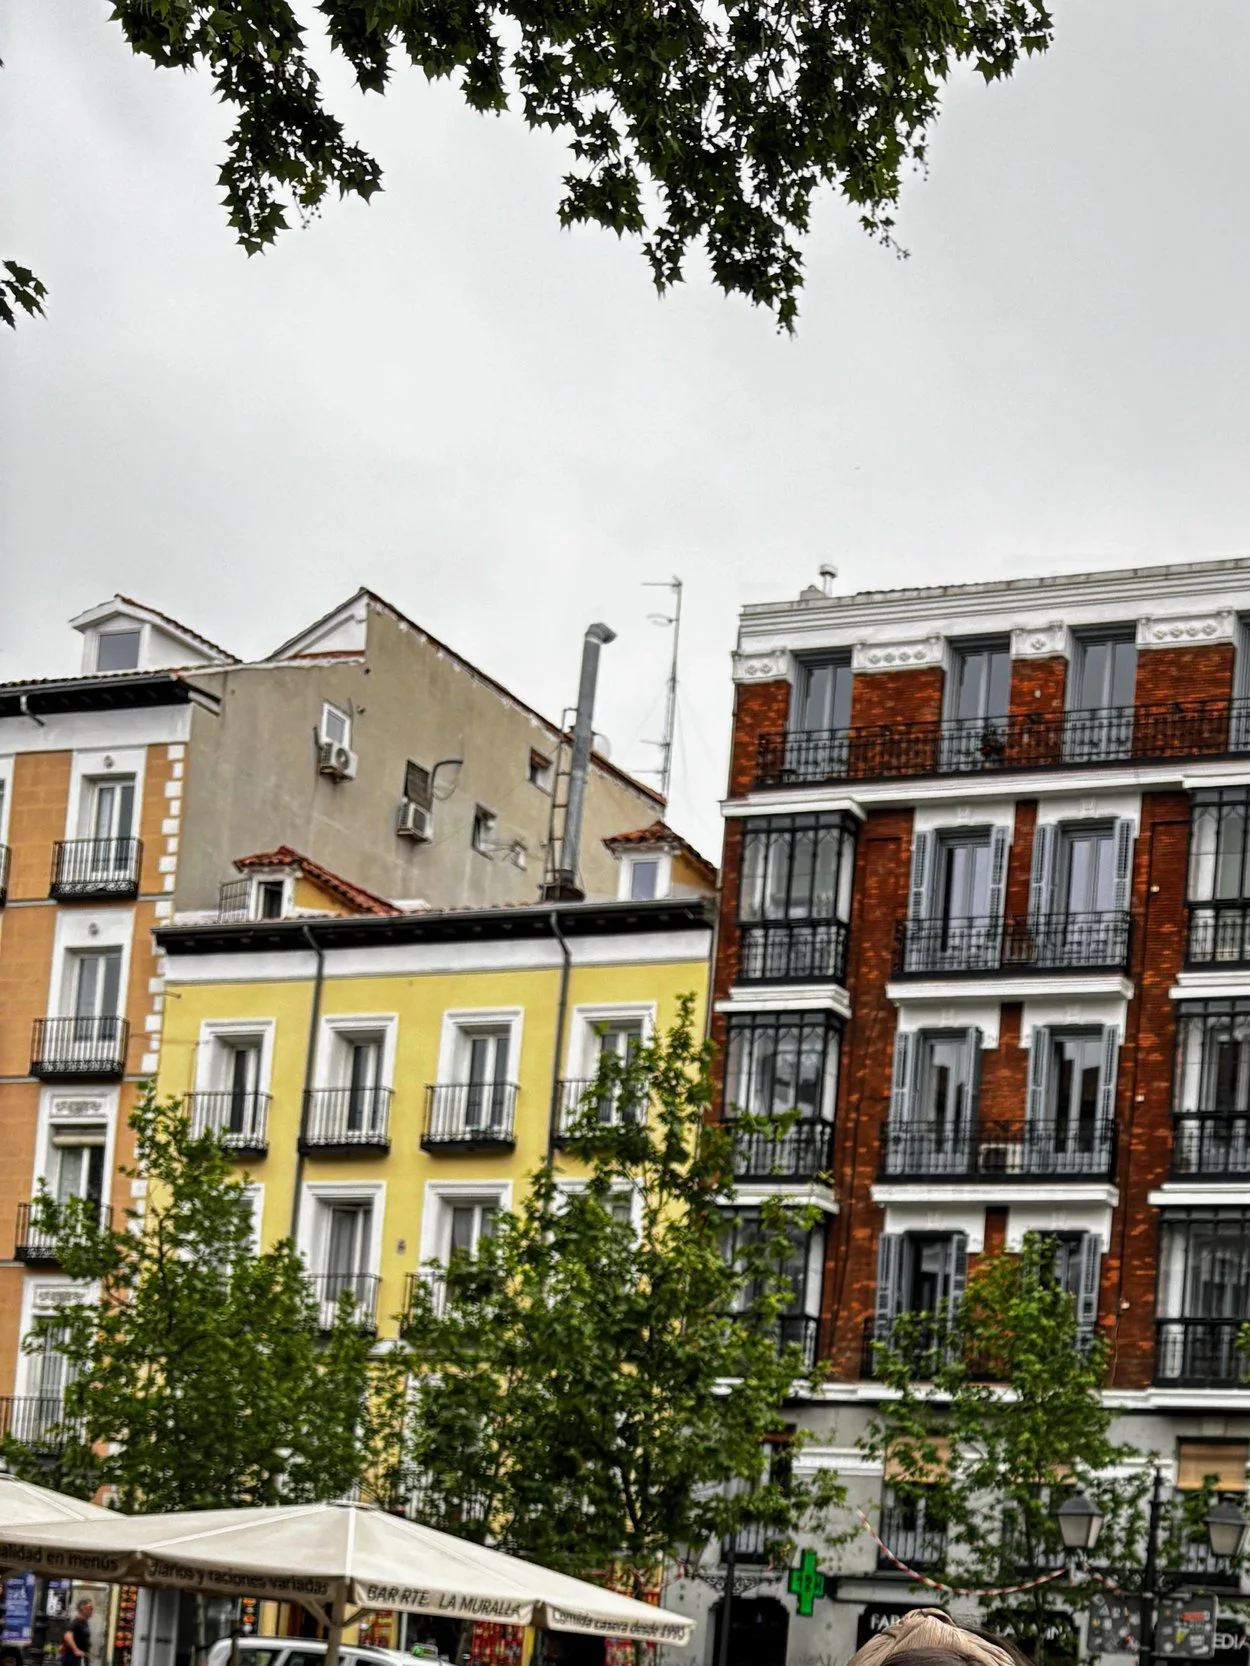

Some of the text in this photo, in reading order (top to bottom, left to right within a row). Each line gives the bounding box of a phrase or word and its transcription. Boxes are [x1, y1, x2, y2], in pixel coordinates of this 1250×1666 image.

[46, 1552, 64, 1566] en
[367, 1584, 399, 1603] BAR
[439, 1594, 458, 1611] LA
[460, 1595, 522, 1618] MURALLA
[552, 1605, 593, 1627] Comida
[594, 1617, 628, 1635] casera
[630, 1619, 660, 1637] desde
